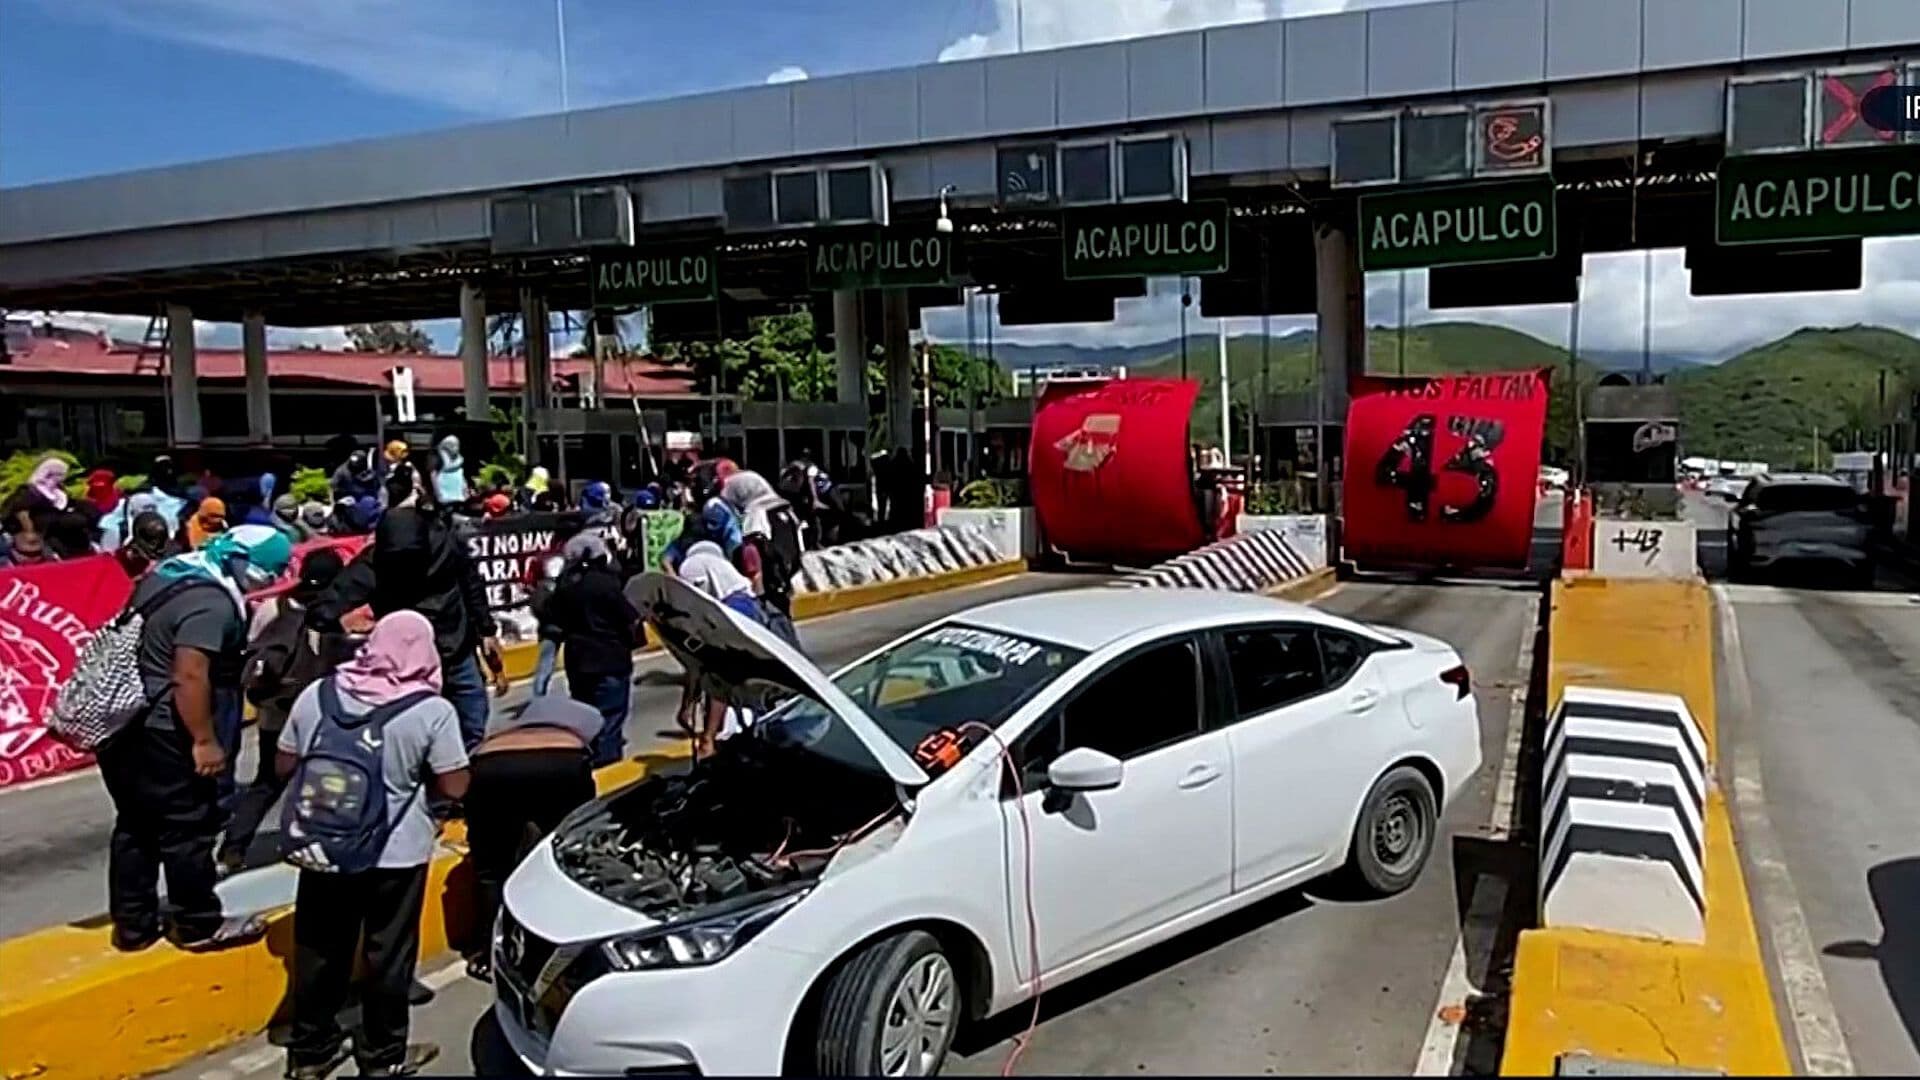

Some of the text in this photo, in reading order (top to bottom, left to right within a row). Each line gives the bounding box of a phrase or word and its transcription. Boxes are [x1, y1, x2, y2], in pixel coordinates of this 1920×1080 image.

[1731, 171, 1920, 221] ACAPULC
[1073, 219, 1218, 259] ACAPULCO
[1371, 201, 1543, 250] ACAPULCO
[600, 255, 708, 290] ACAPULCO
[815, 237, 941, 274] ACAPULCO
[1452, 374, 1536, 400] FALTAN
[1373, 412, 1504, 523] 43
[467, 530, 555, 557] SI NO HAY
[478, 558, 521, 582] ARA
